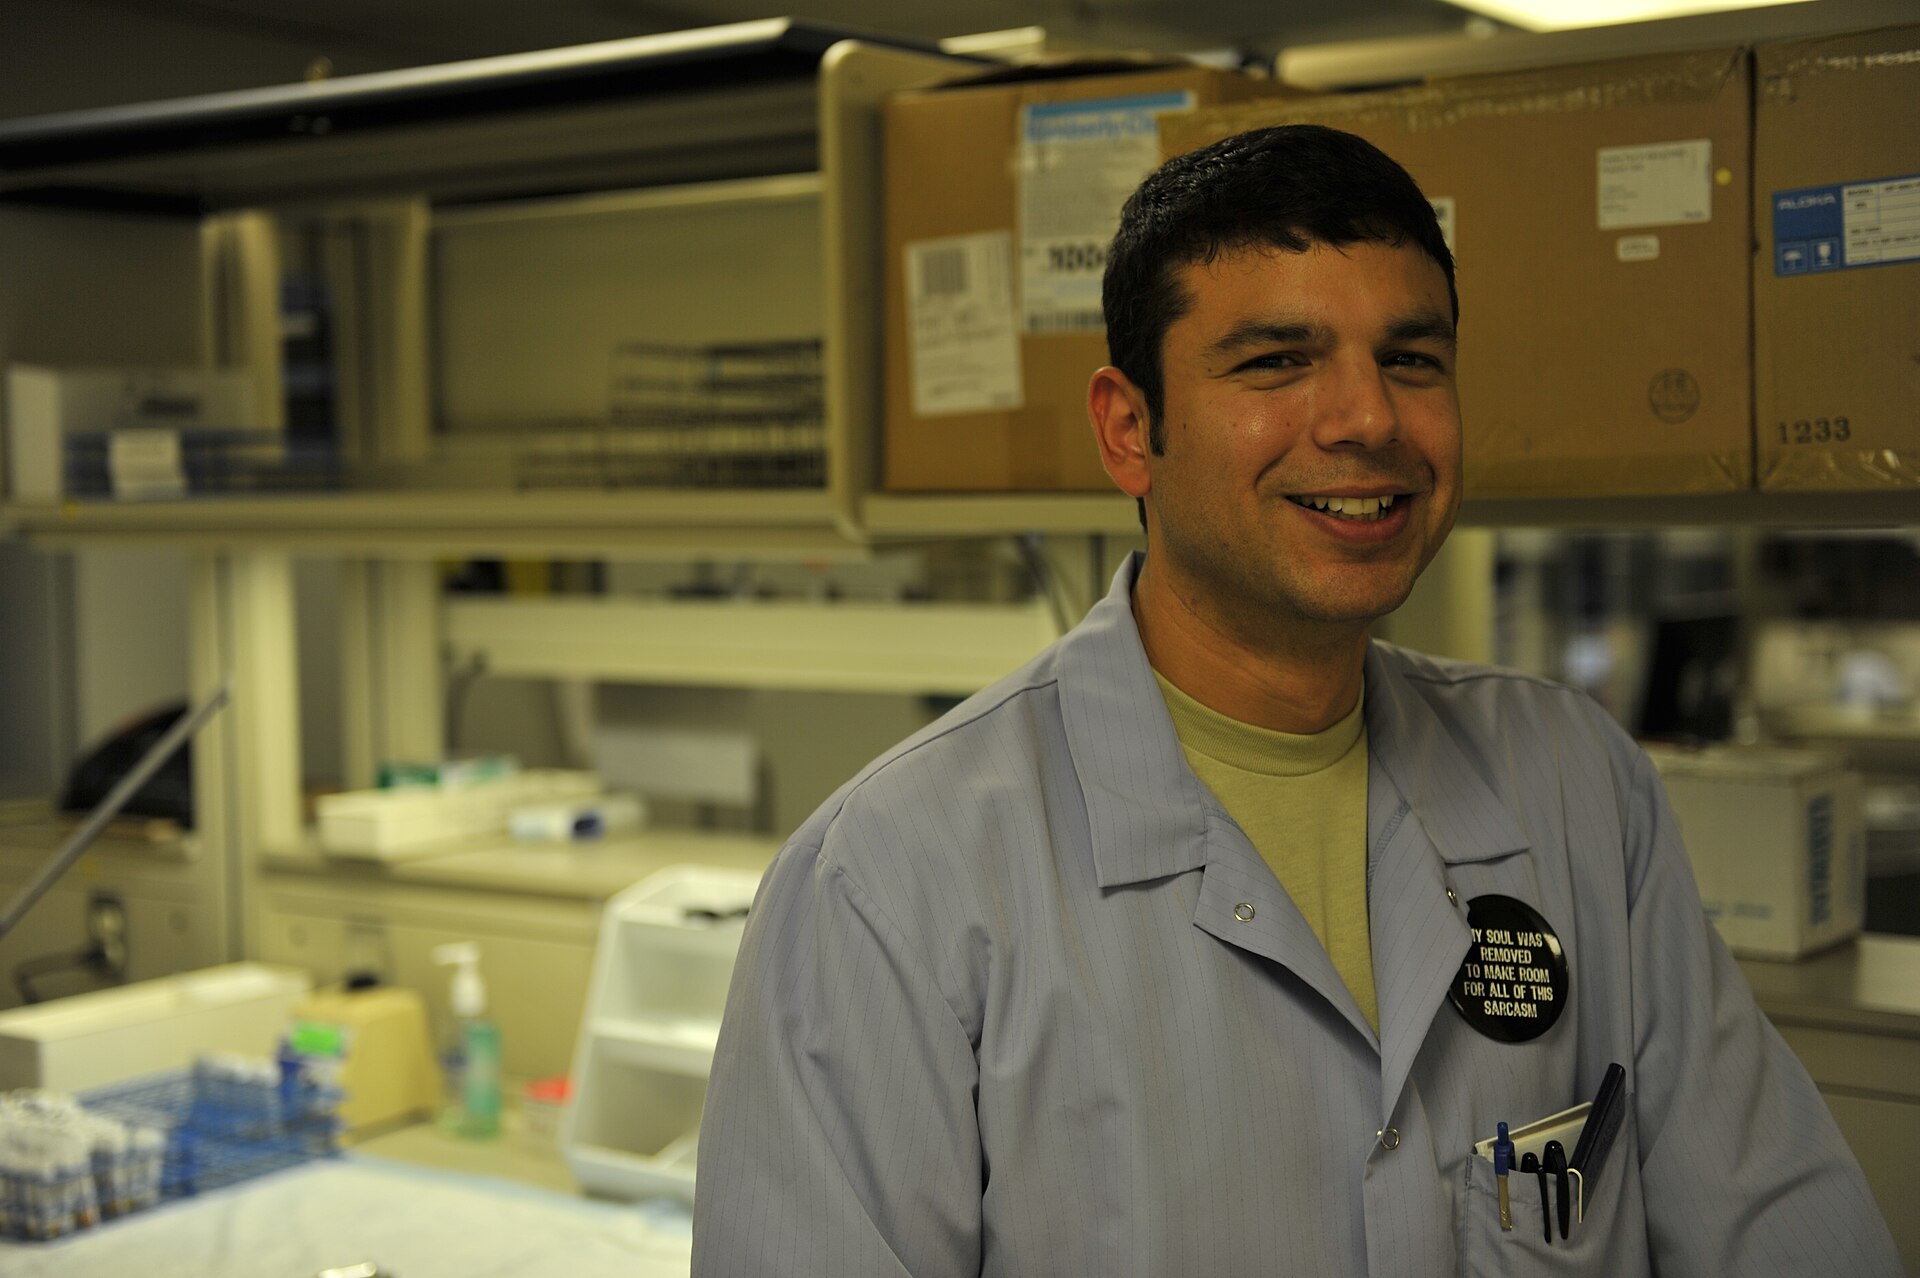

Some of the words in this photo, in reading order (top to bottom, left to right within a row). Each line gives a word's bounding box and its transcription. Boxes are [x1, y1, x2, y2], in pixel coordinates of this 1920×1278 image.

[1777, 416, 1851, 444] 1233
[1486, 929, 1514, 945] SOUL
[1517, 931, 1543, 947] WAS
[1480, 947, 1532, 964] REMOVED
[1465, 963, 1480, 978] TO
[1484, 965, 1516, 981] MAKE
[1519, 967, 1550, 983] ROOM
[1464, 982, 1485, 997] FOR
[1489, 982, 1510, 998] ALL
[1513, 985, 1527, 999] OF
[1530, 986, 1554, 1001] THIS
[1484, 1001, 1538, 1018] SARCASM
